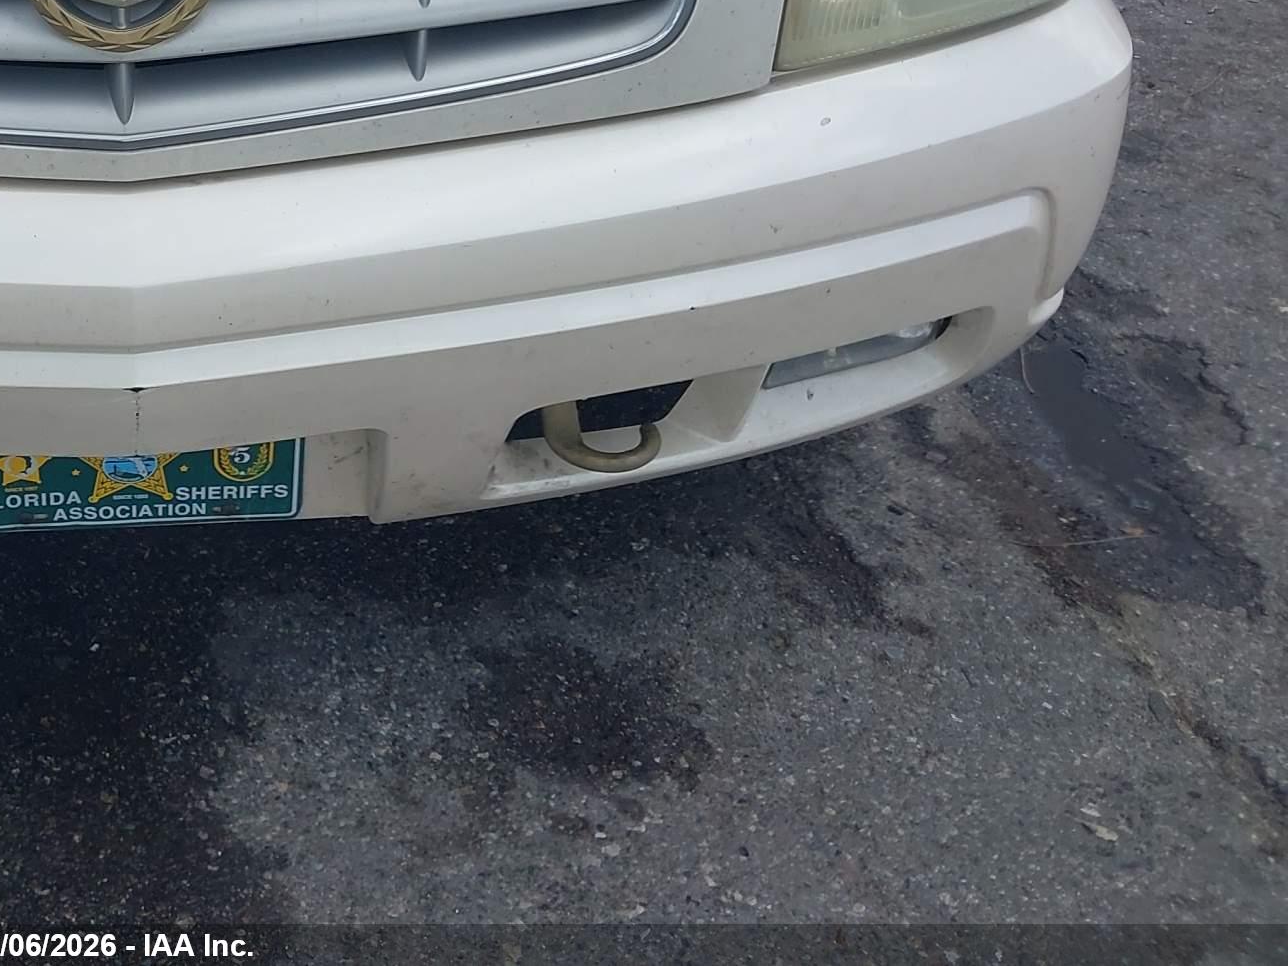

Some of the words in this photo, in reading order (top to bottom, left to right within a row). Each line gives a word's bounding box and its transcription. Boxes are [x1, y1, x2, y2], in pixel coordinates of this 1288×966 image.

[233, 446, 251, 464] 5
[175, 484, 289, 501] SHERIFFS
[52, 503, 207, 522] ASSOCIATION
